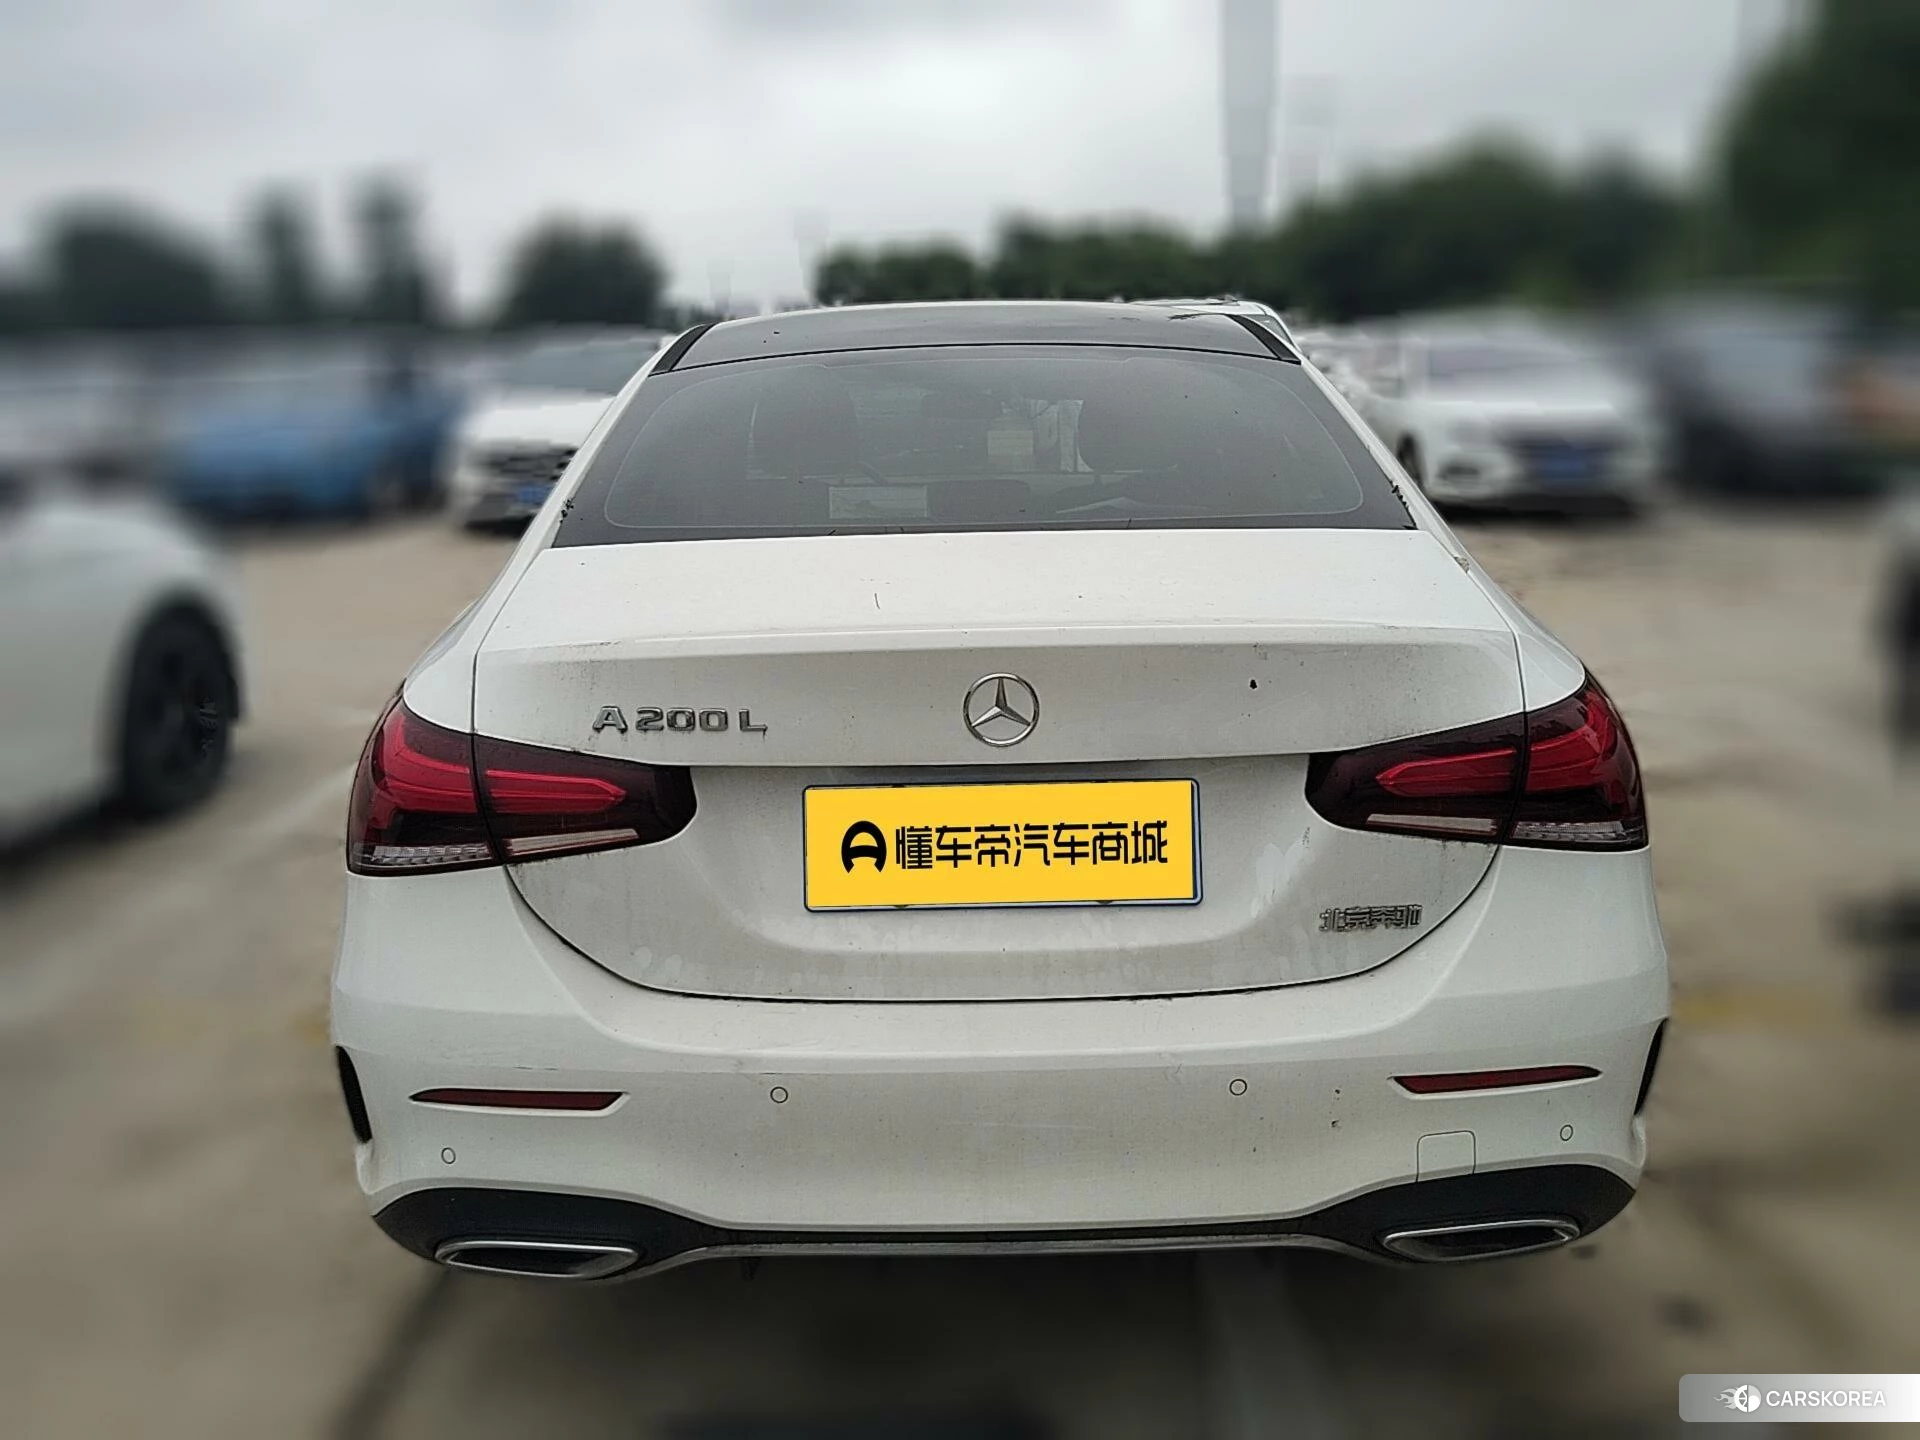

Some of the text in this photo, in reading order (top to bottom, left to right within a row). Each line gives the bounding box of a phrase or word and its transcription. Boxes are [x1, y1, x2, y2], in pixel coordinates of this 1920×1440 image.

[593, 706, 768, 733] A 200 L
[1319, 904, 1422, 932] 北京奔驰
